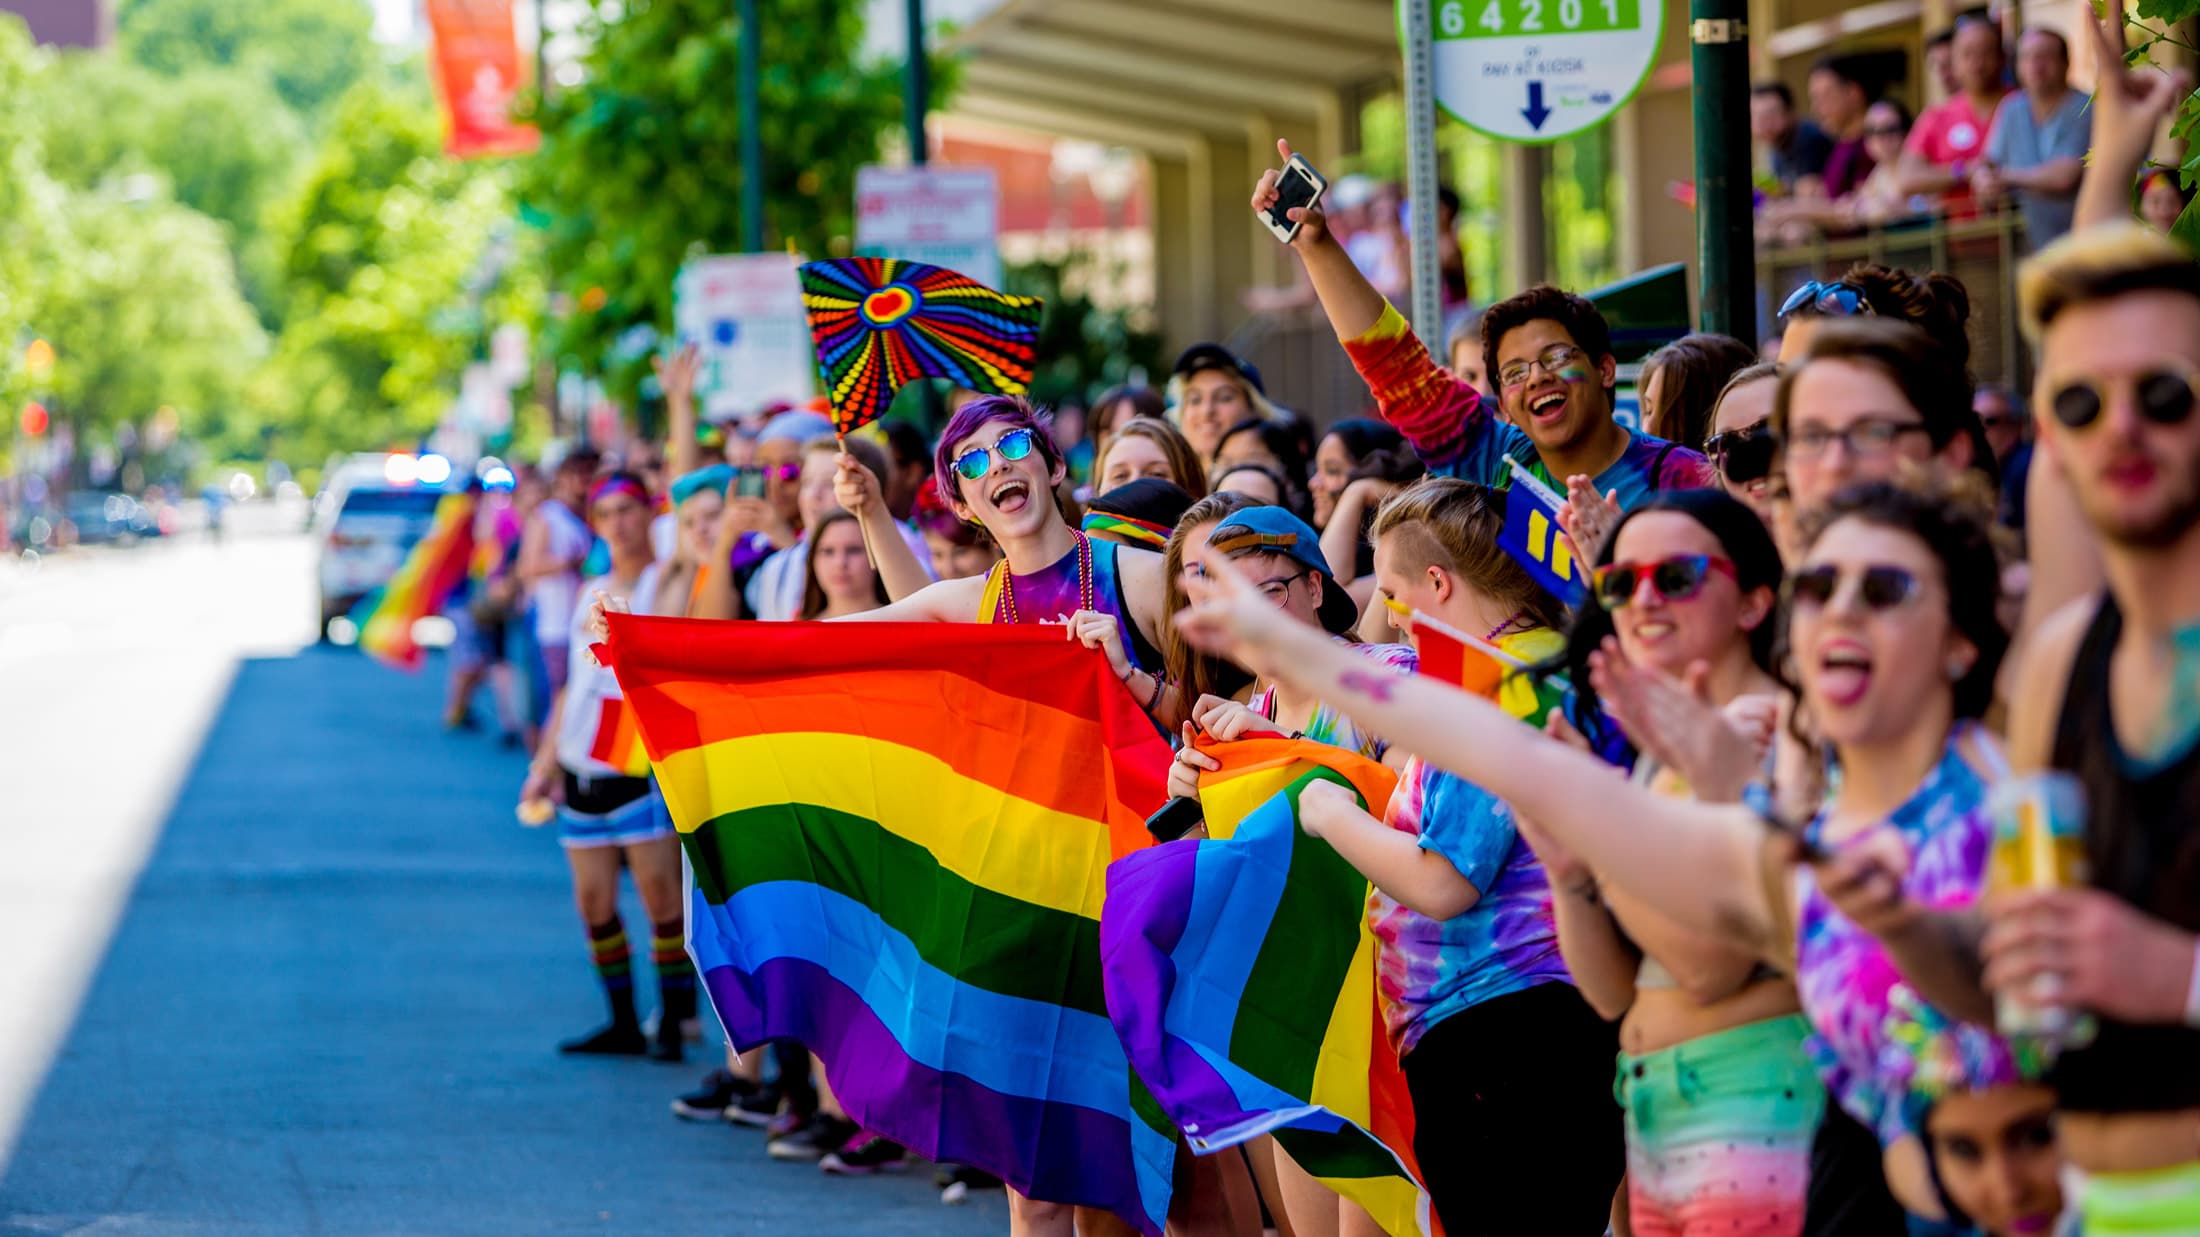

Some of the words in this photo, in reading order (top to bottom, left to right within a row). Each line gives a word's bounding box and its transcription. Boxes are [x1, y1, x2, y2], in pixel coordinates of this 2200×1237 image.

[1482, 62, 1509, 76] PAY
[1515, 61, 1532, 75] AT
[1536, 58, 1585, 74] KIOSK
